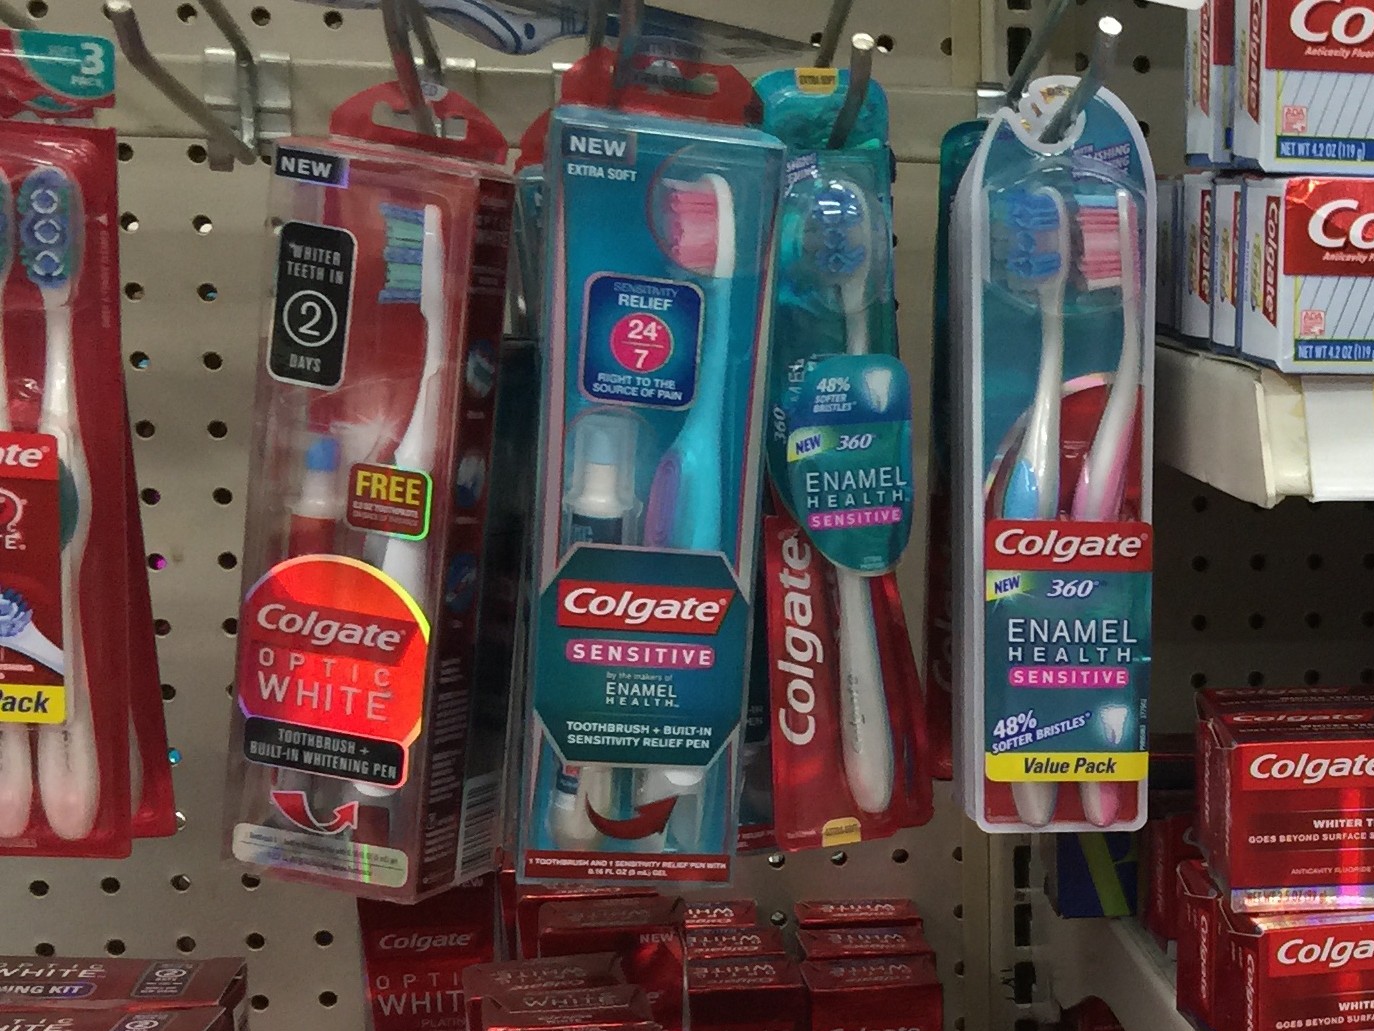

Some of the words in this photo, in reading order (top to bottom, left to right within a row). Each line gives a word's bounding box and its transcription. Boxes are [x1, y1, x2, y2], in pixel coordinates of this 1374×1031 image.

[80, 43, 103, 75] 3
[570, 136, 626, 157] NEW
[280, 155, 332, 178] NEW
[568, 164, 604, 178] EXTRA
[608, 169, 637, 181] SOFT
[288, 262, 321, 282] TEETH
[327, 265, 344, 283] IN
[618, 294, 672, 310] RELIEF
[298, 302, 321, 336] 2
[627, 320, 658, 340] 24
[289, 354, 320, 373] DAYS
[633, 349, 648, 368] 7
[592, 382, 631, 395] SOURCE
[634, 386, 651, 397] OF
[653, 389, 682, 400] PAIN
[816, 377, 850, 393] 48%
[795, 434, 821, 454] NEW
[355, 470, 420, 506] FREE
[806, 467, 907, 492] ENAMEL
[807, 490, 904, 508] HEALTH
[811, 509, 901, 528] SENSITIVE
[994, 528, 1141, 562] Colgate
[994, 575, 1021, 594] NEW
[1047, 579, 1094, 597] 360
[563, 587, 720, 624] Colgate
[256, 602, 403, 652] Colgate
[1008, 618, 1137, 643] ENAMEL
[778, 538, 824, 746] Colgate
[573, 643, 711, 665] SENSITIVE
[1008, 647, 1131, 662] HEALTH
[258, 647, 391, 688] OPTIC
[1014, 670, 1126, 684] SENSITIVE
[257, 673, 389, 721] WHITE
[606, 682, 678, 698] ENAMEL
[0, 691, 49, 713] ack
[606, 697, 674, 707] HEALTH
[566, 722, 649, 734] TOOTHBRUSH
[663, 725, 712, 736] BUILT-IN
[992, 734, 1033, 754] SOFTER
[1037, 715, 1086, 740] BRISTLES
[993, 711, 1037, 739] 48%
[278, 727, 356, 755] TOOTHBRUSH
[568, 735, 639, 748] SENSITIVITY
[643, 737, 683, 748] RELIEF
[686, 738, 709, 749] PEN
[302, 750, 370, 776] WHITENING
[373, 764, 397, 779] PEN
[1024, 758, 1069, 774] Value
[1074, 758, 1117, 774] Pack
[1313, 817, 1363, 829] WHITER
[1248, 835, 1276, 845] GOES
[1279, 833, 1319, 844] BEYOND
[1322, 831, 1366, 842] SURFACE
